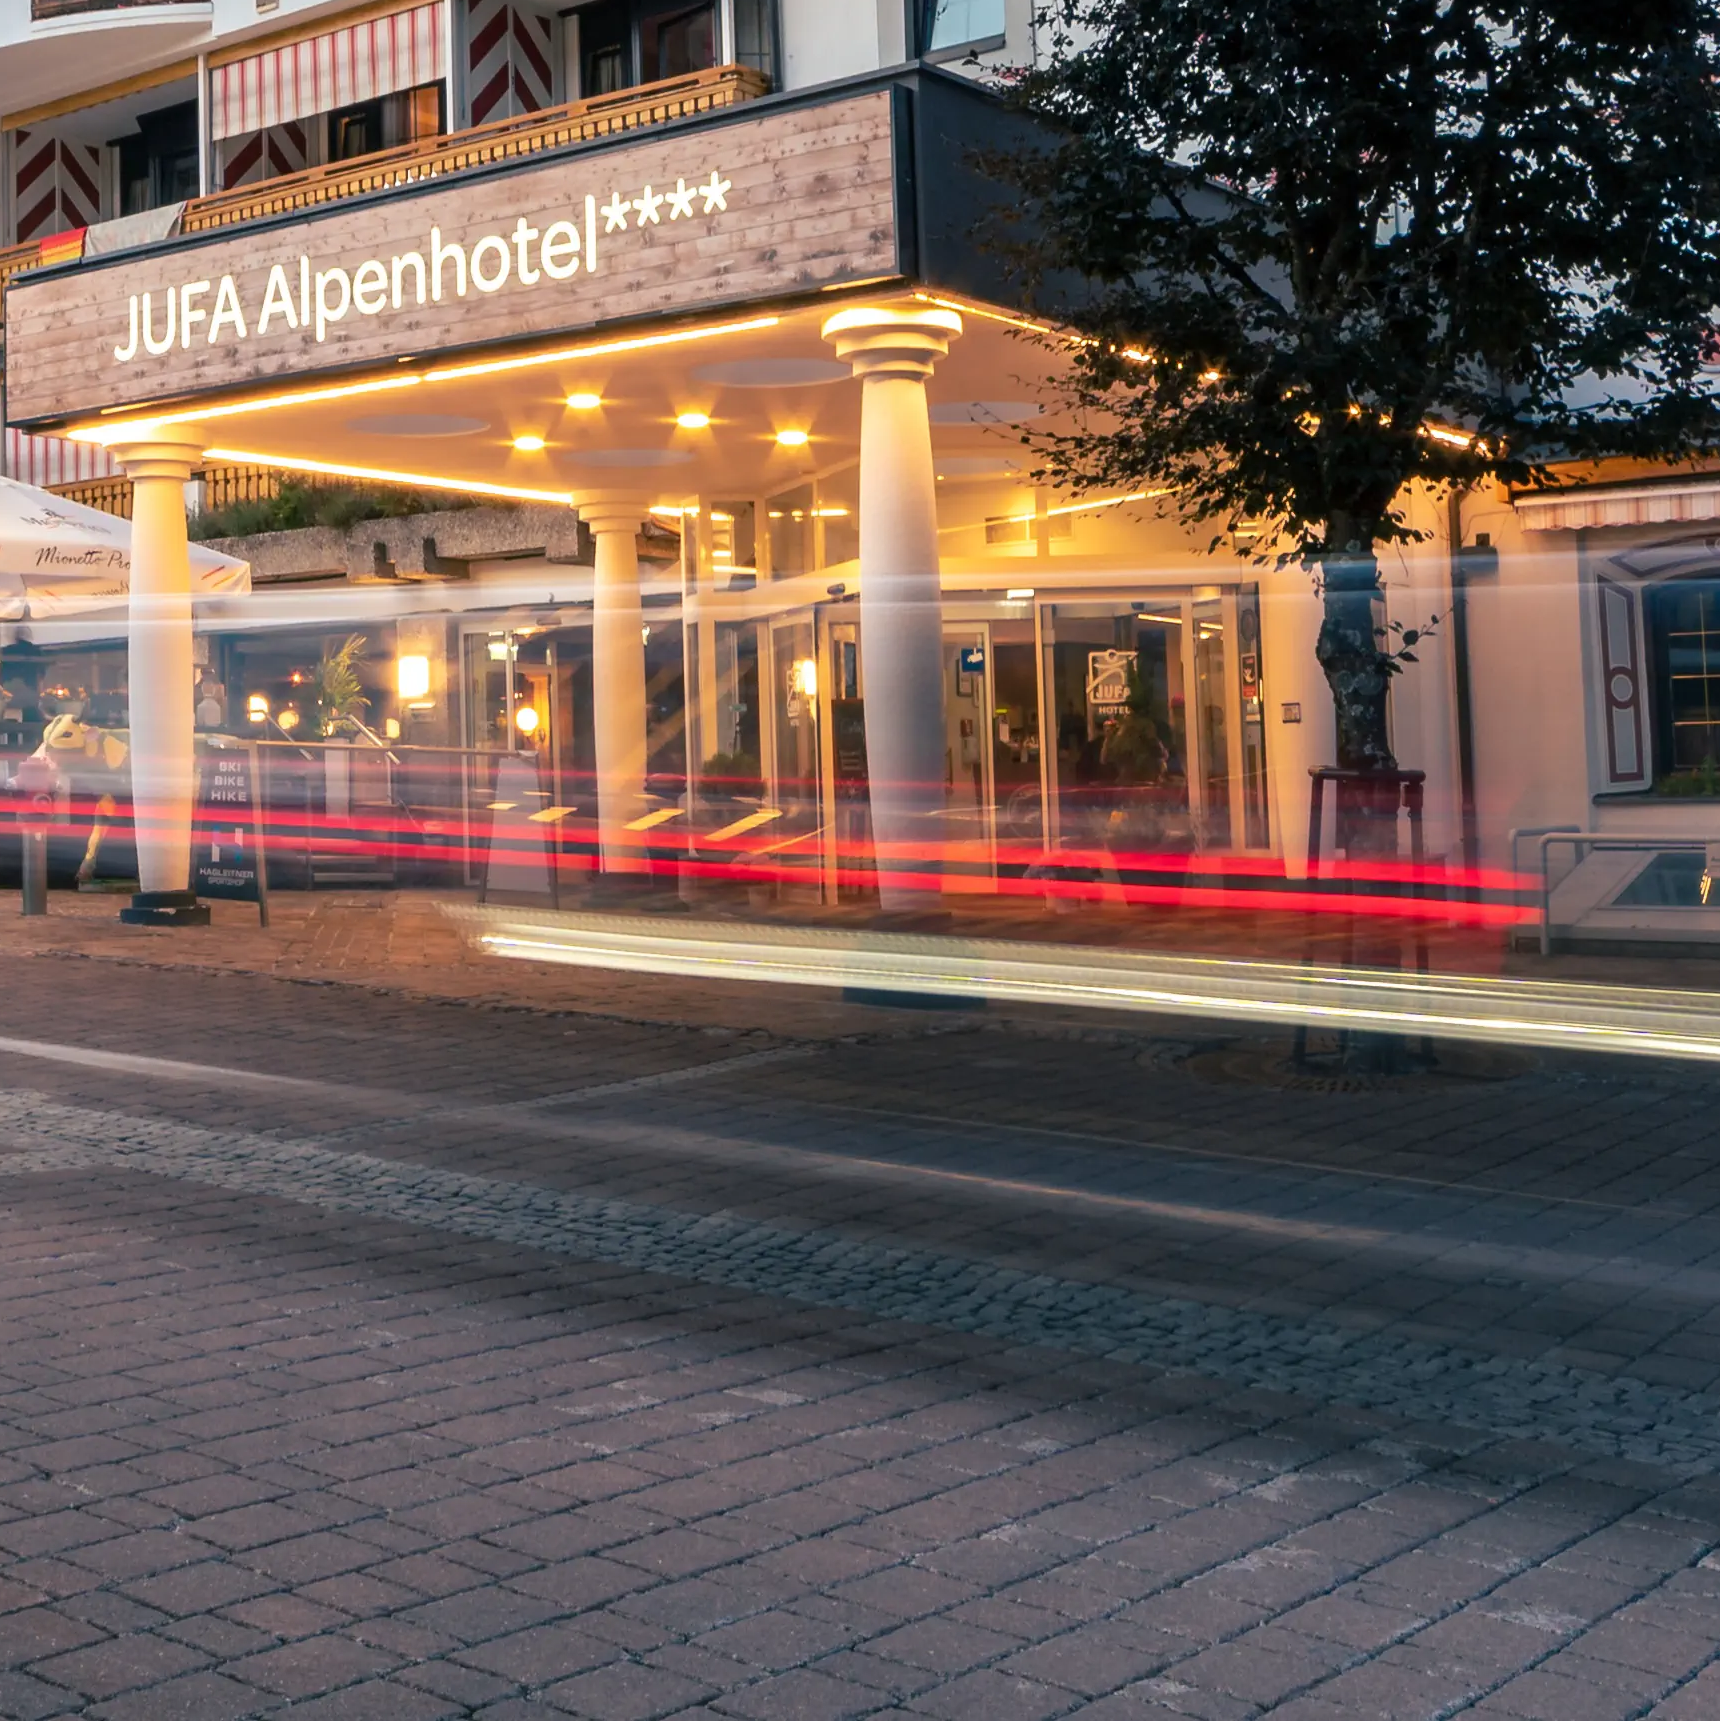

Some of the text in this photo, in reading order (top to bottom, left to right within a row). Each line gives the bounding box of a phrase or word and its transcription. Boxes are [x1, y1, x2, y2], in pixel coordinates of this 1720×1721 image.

[113, 194, 598, 363] JUFA Alpenhotel
[35, 546, 107, 567] Mionetto
[219, 761, 241, 772] SKI
[214, 776, 245, 787] BIKE
[211, 791, 247, 802] HIKE
